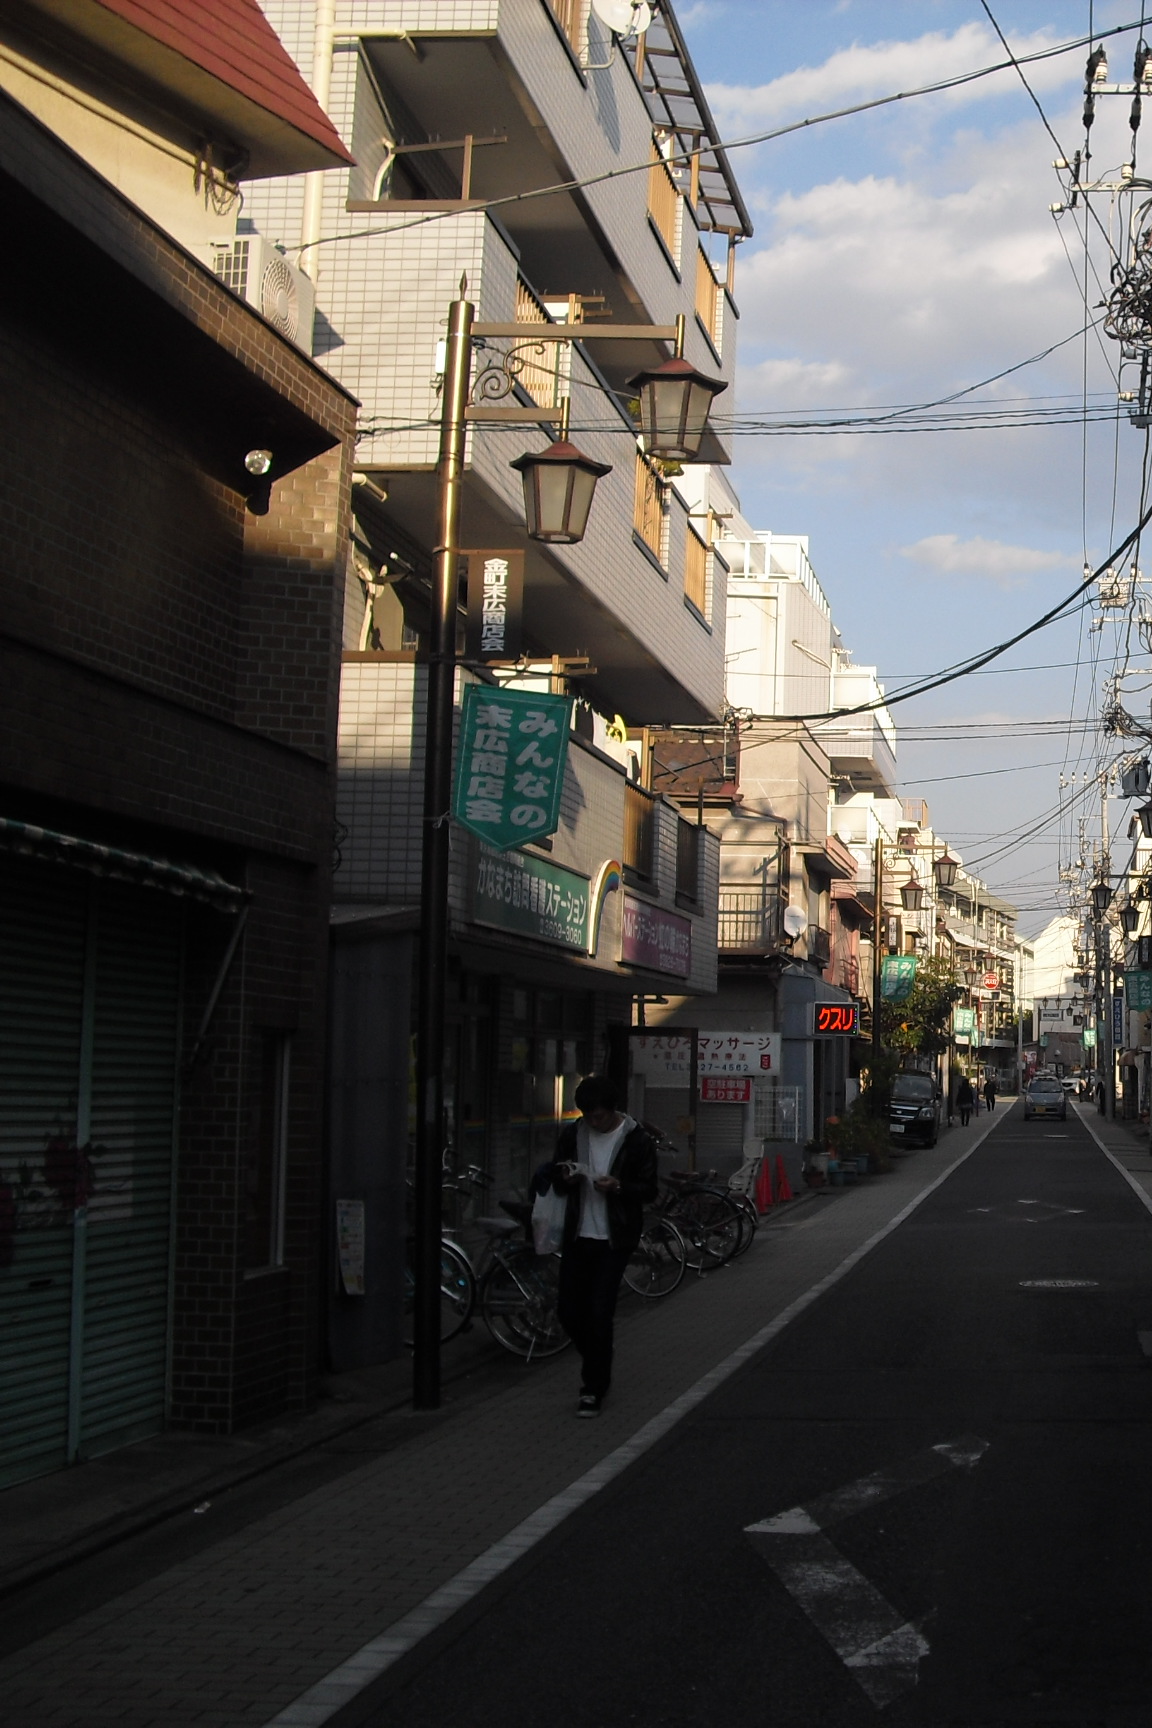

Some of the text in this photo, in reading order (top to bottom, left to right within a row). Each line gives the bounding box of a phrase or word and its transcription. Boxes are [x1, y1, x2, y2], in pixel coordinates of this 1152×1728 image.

[480, 557, 509, 652] 金町末広商店会
[465, 704, 514, 824] 末広商店会
[509, 711, 558, 829] みんなの
[817, 1006, 854, 1032] クスリ
[706, 1090, 745, 1100] あります
